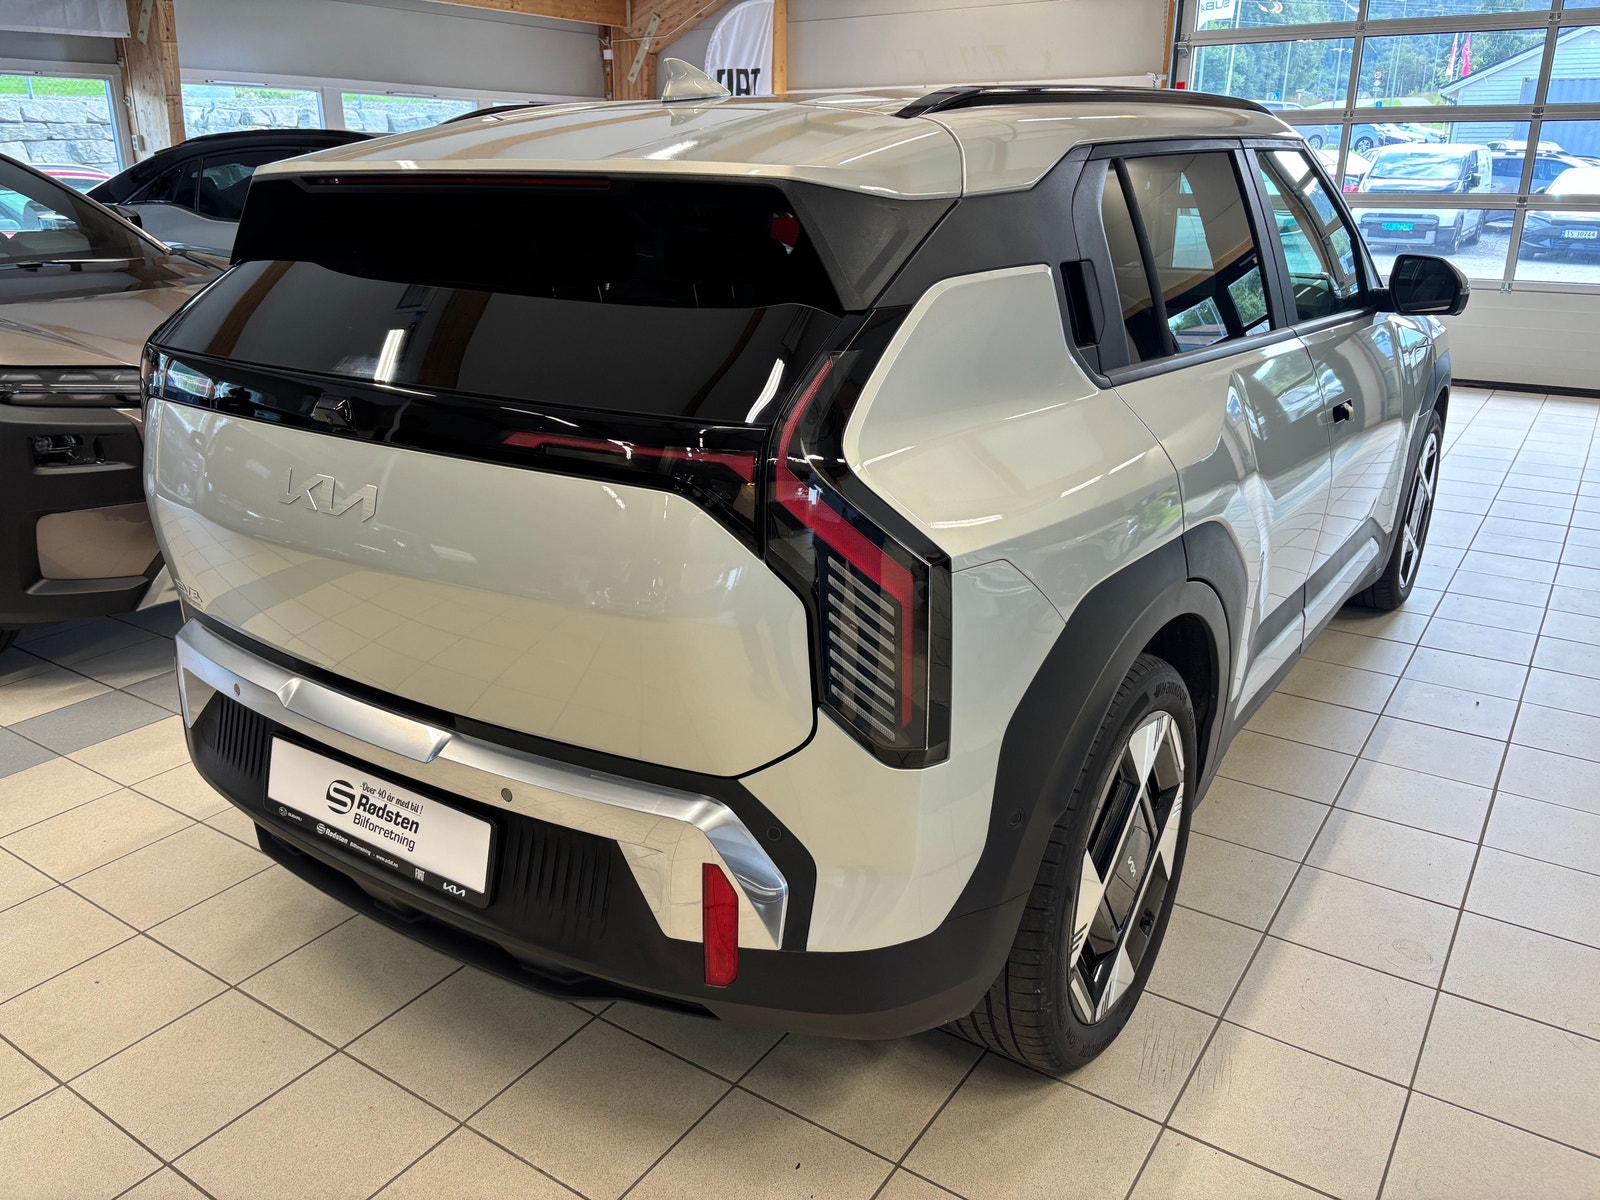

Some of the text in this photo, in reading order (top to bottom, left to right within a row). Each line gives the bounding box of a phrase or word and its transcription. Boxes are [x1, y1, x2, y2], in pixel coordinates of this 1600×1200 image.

[279, 466, 379, 524] KIA
[377, 787, 387, 799] 40
[352, 812, 416, 852] Bilforretning
[356, 793, 420, 834] Rødsten
[443, 882, 466, 897] KIA
